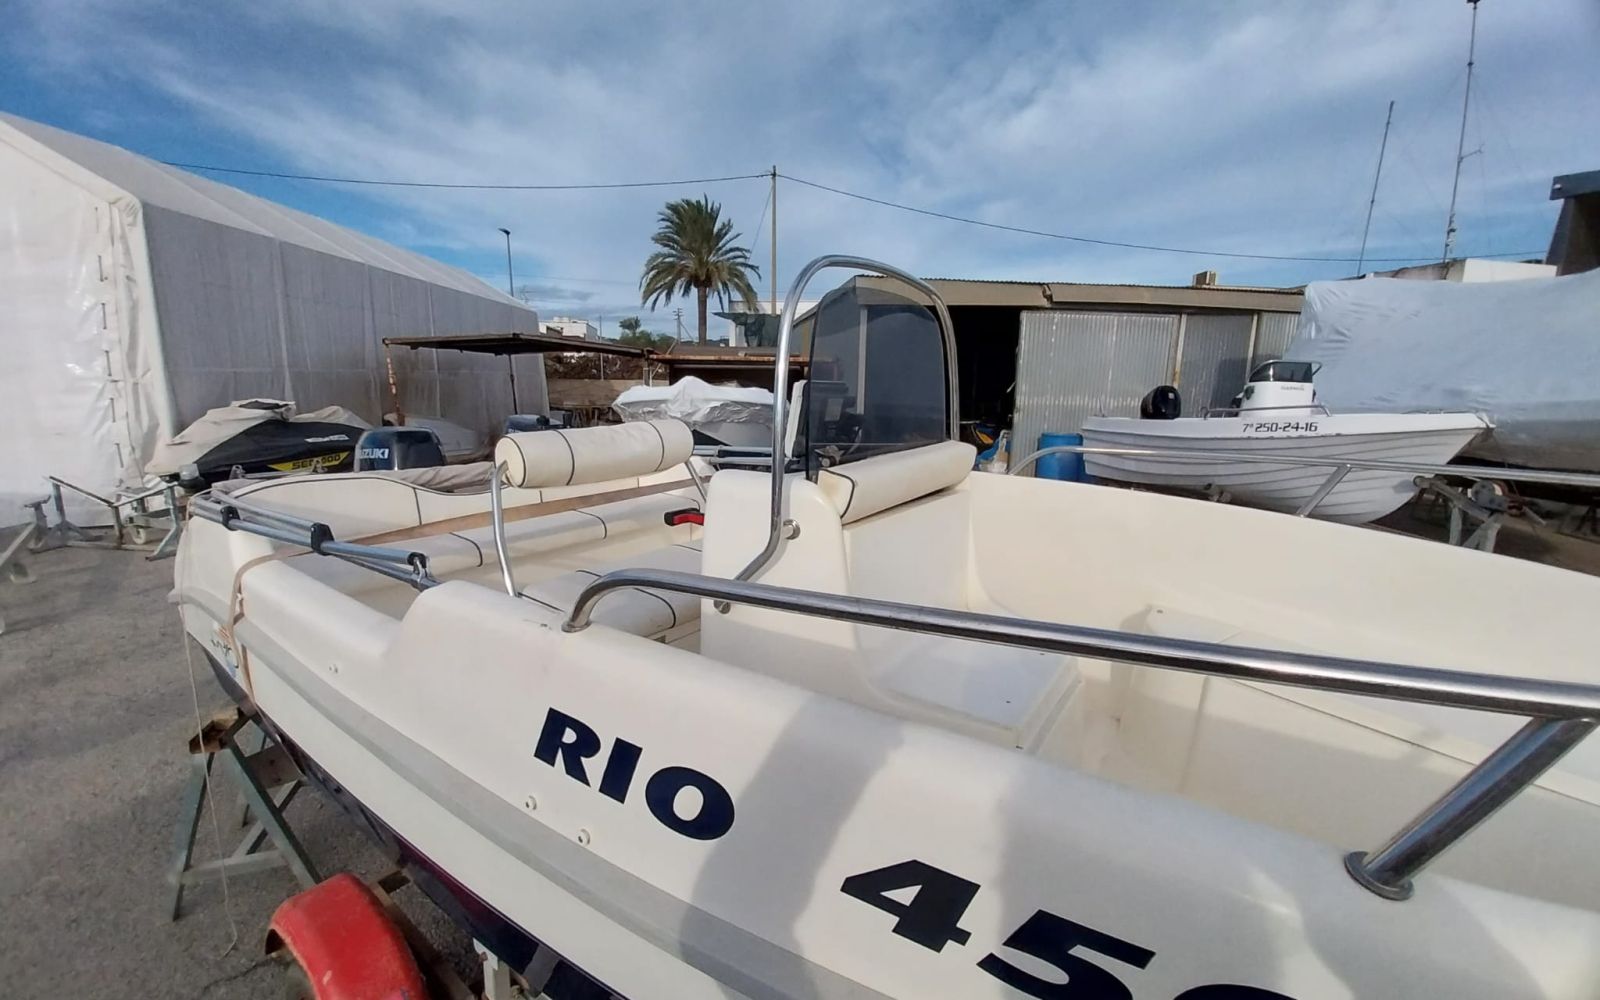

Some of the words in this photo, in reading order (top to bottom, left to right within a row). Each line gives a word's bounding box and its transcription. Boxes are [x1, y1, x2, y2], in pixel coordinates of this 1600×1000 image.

[1255, 422, 1318, 433] 250-24-16
[359, 448, 389, 459] ZUKI
[292, 454, 341, 470] SEADOO
[534, 707, 735, 841] RIO
[840, 860, 1298, 1000] 45
